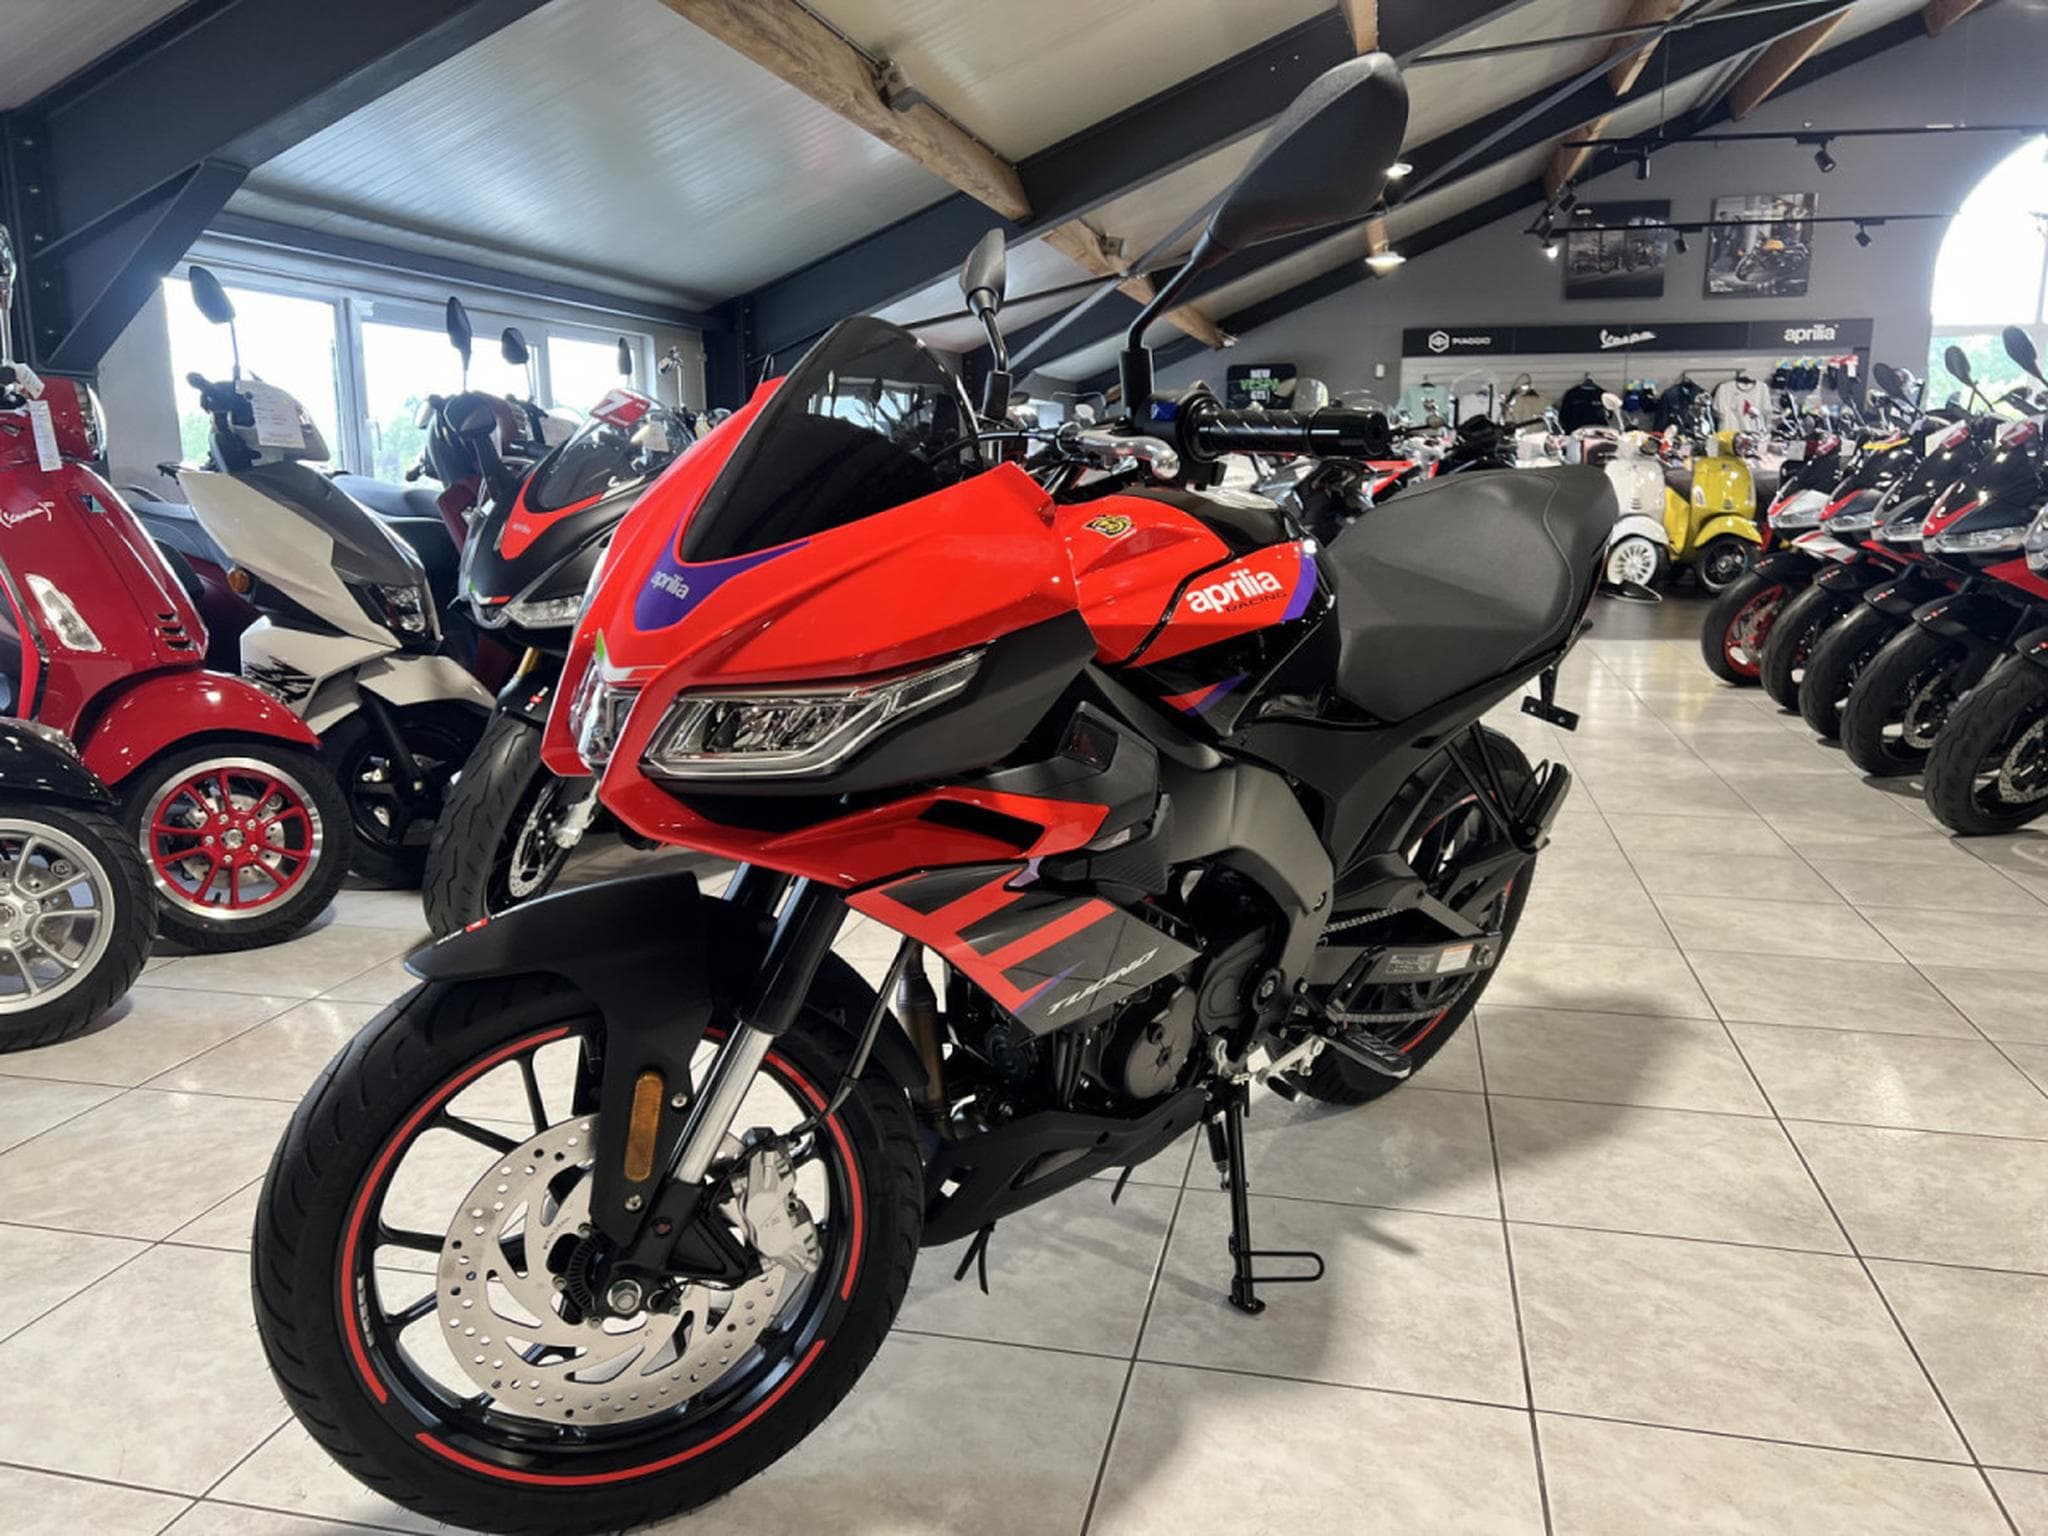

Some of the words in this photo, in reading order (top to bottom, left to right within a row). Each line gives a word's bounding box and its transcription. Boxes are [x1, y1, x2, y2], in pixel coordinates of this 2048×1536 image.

[1451, 337, 1491, 346] PIAGGIO
[1600, 329, 1656, 349] Vespa
[1784, 324, 1836, 344] aprilia
[650, 570, 690, 600] aprilia
[1185, 567, 1284, 614] aprilia
[1045, 946, 1159, 1017] TUONO
